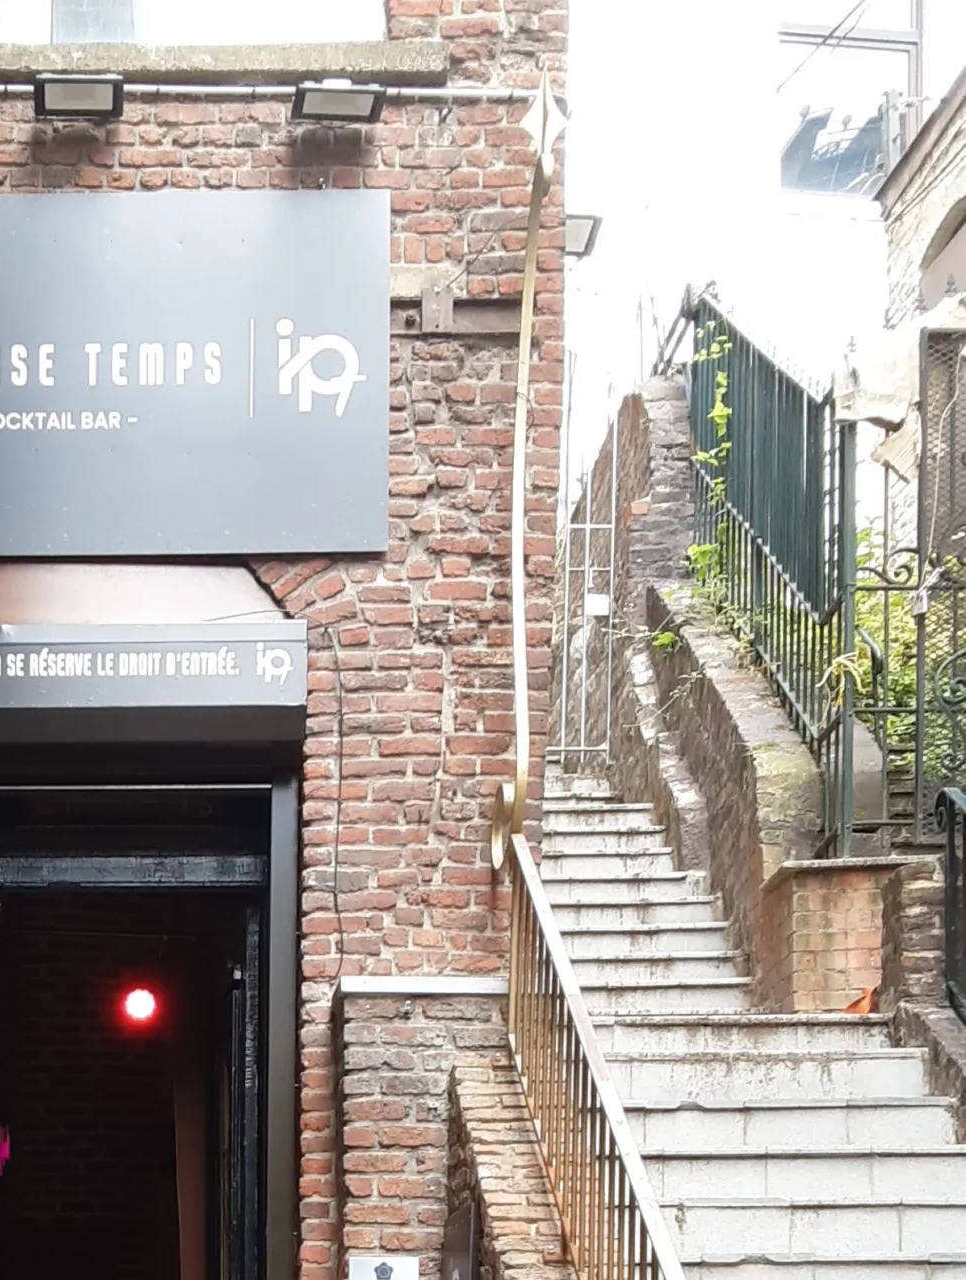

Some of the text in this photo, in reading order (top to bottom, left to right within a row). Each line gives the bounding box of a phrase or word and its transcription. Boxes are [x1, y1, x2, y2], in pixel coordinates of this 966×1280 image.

[84, 341, 223, 386] TEMPS
[81, 411, 122, 430] BAR
[6, 653, 25, 676] SE
[29, 647, 92, 676] RÉSERVE
[97, 652, 114, 676] LE
[119, 652, 162, 676] DROIT
